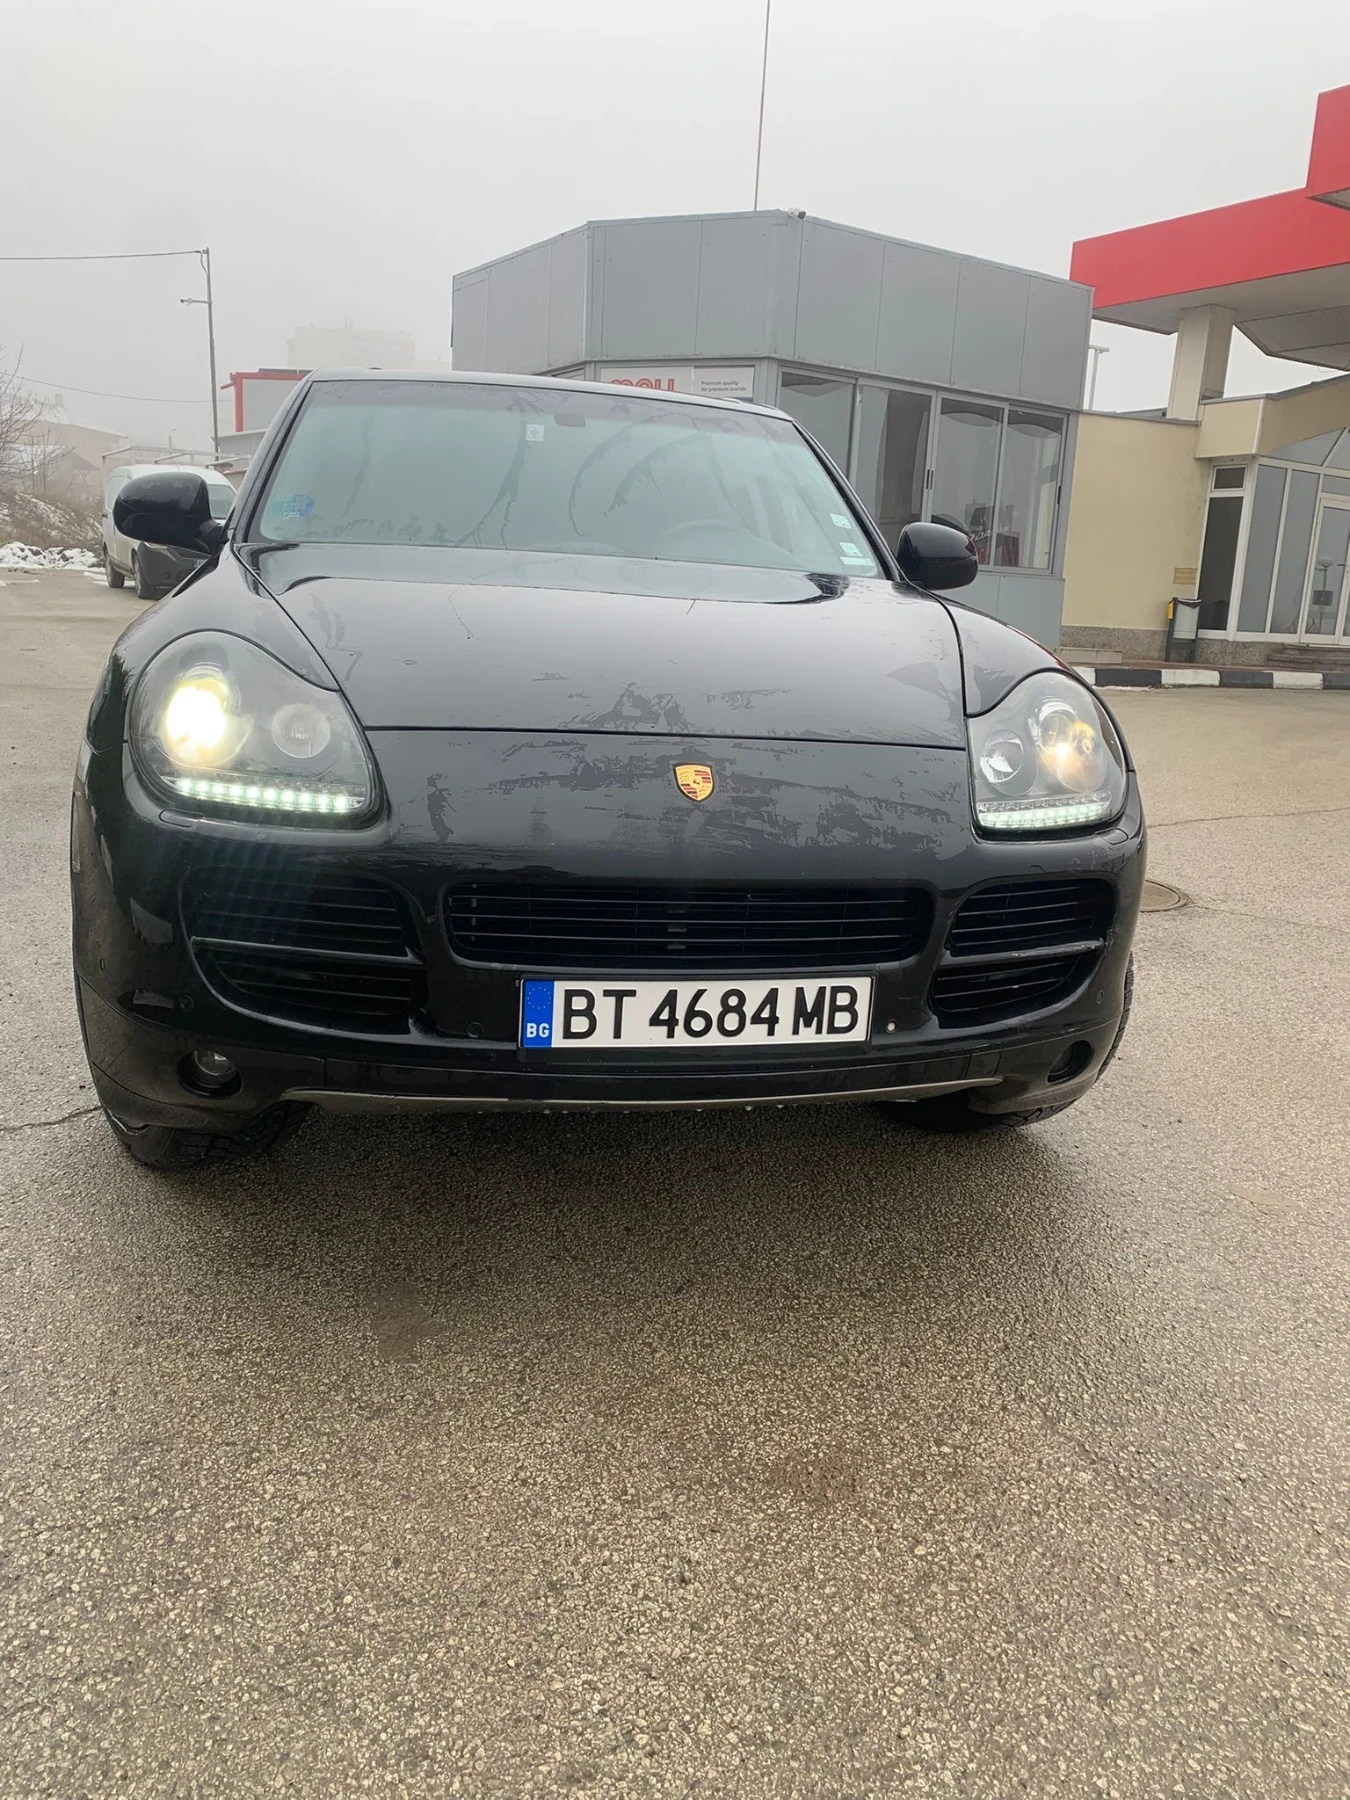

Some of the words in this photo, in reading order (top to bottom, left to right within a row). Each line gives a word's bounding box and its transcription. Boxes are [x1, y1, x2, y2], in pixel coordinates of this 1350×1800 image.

[562, 988, 637, 1039] BT
[649, 987, 780, 1038] 4684
[792, 985, 859, 1035] MB
[526, 1023, 550, 1038] BG
